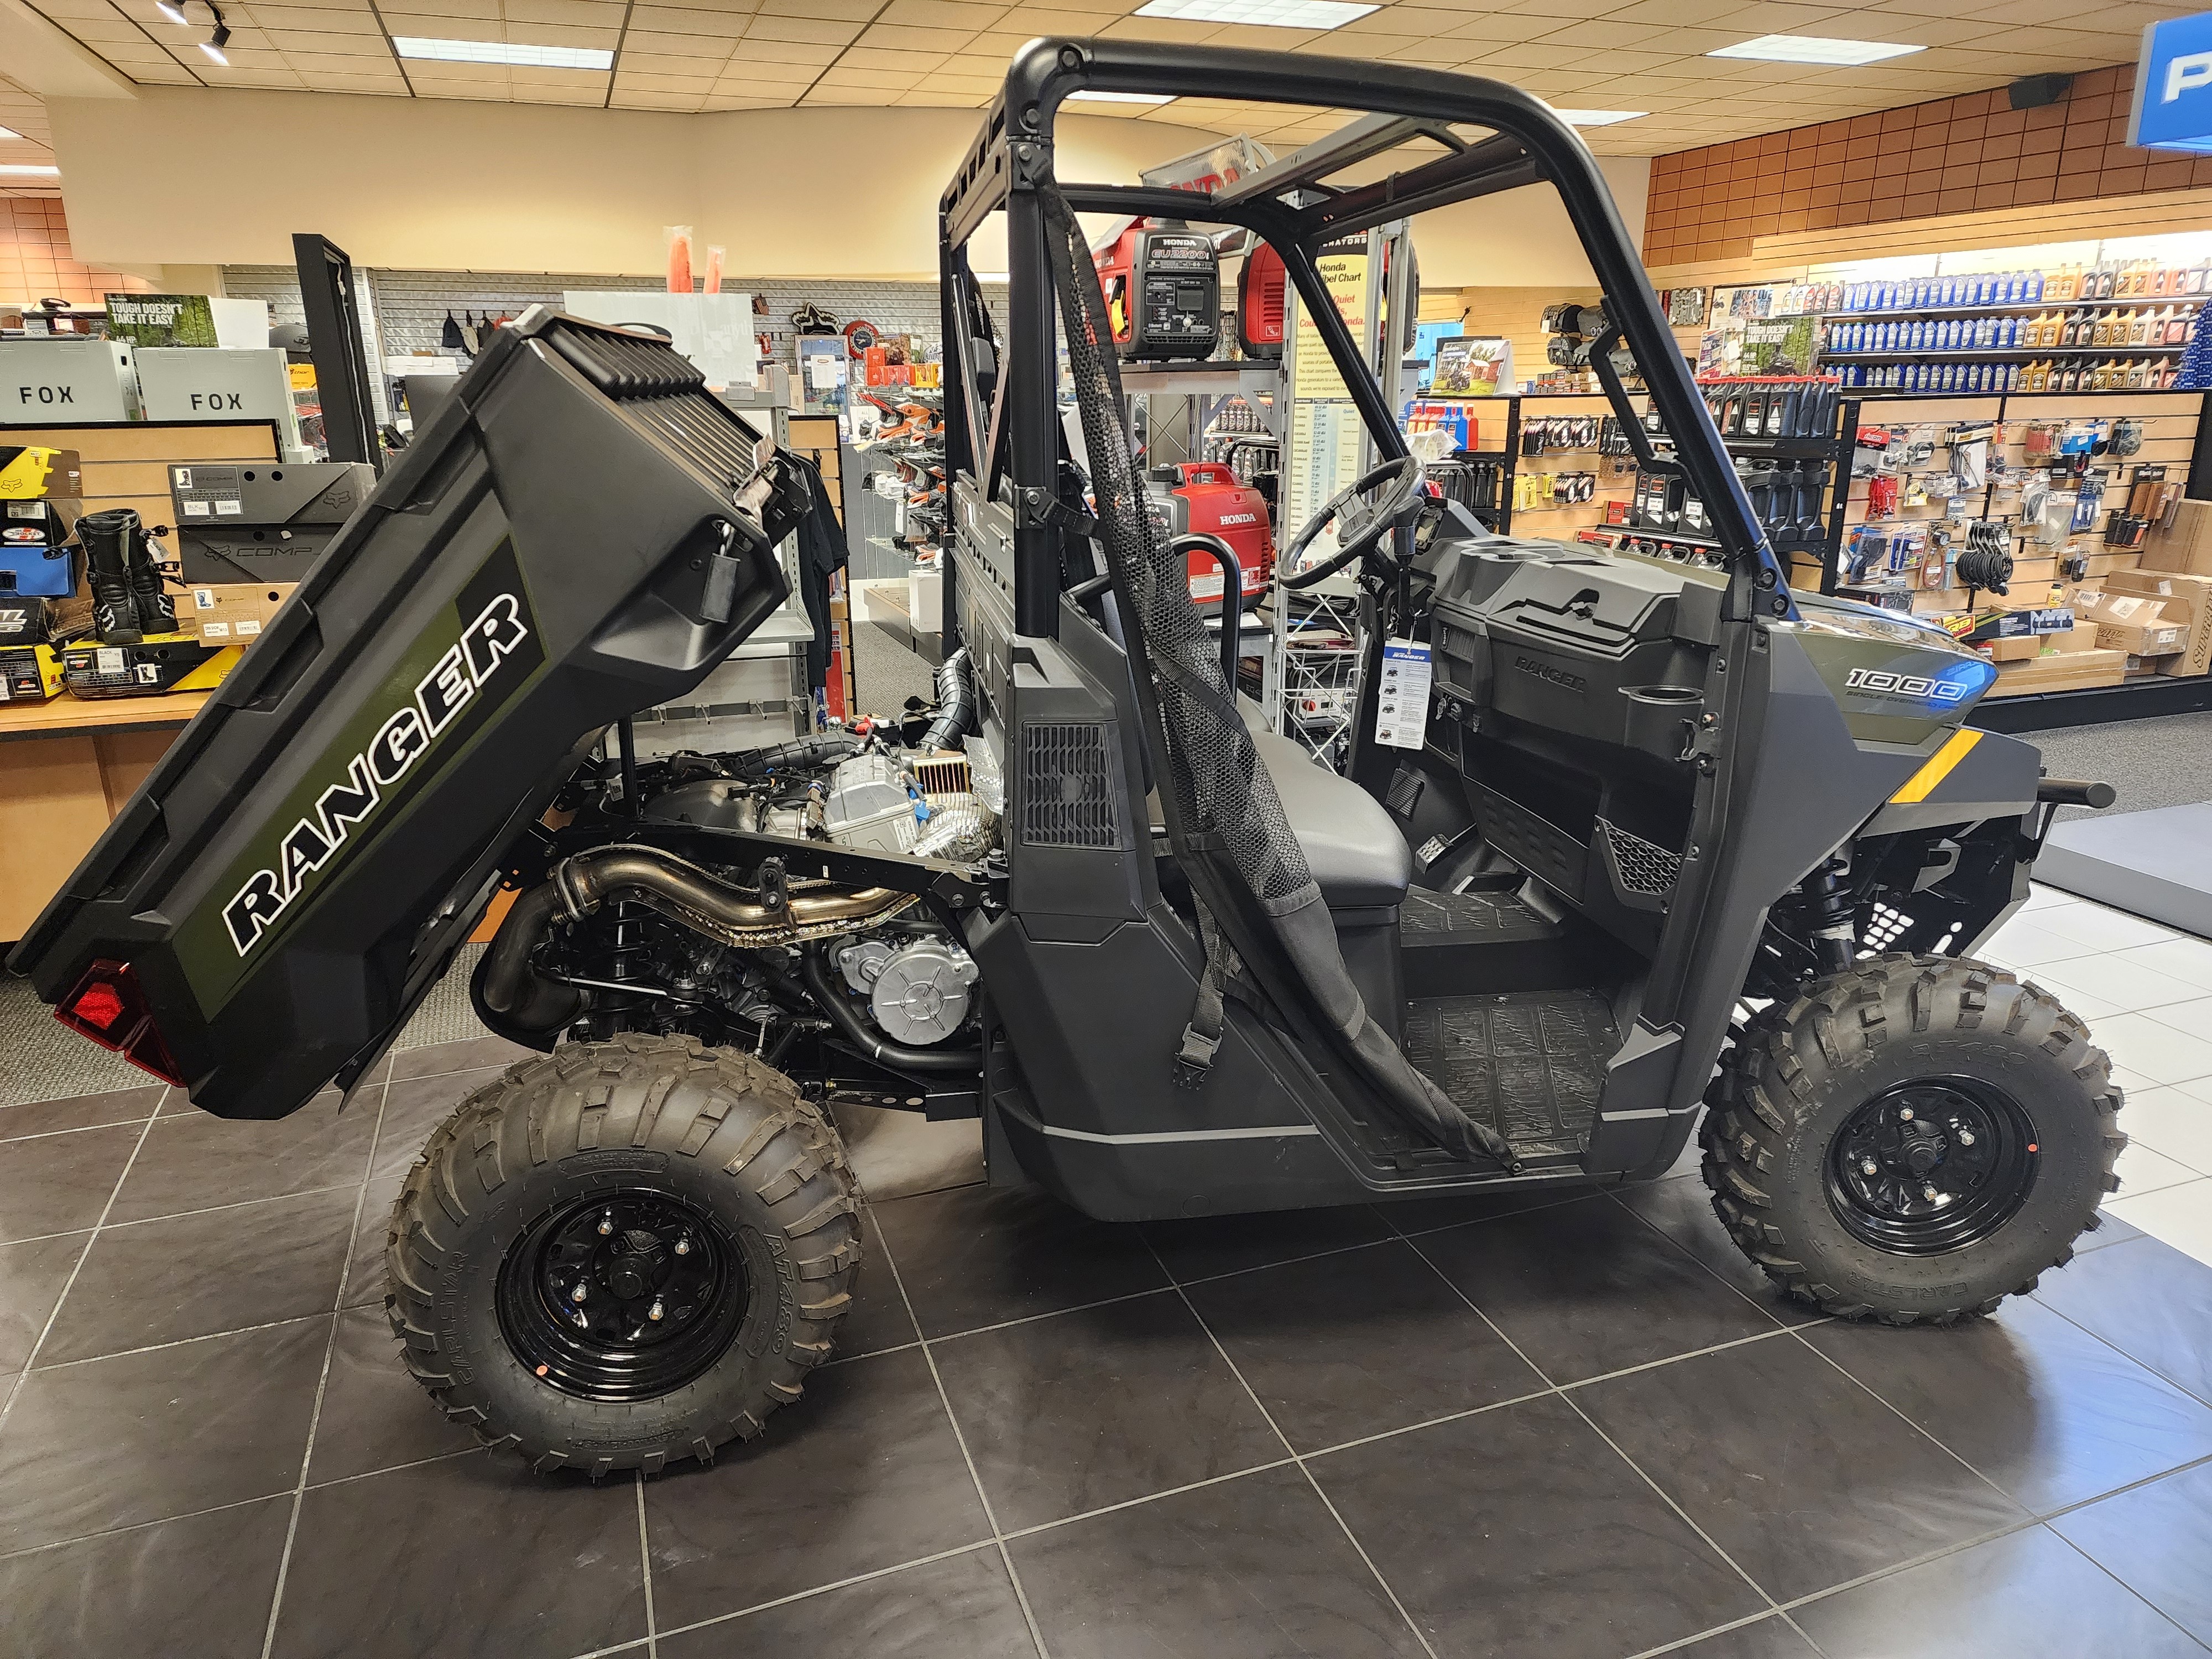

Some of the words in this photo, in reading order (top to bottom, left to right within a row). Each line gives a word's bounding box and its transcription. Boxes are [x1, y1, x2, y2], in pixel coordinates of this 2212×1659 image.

[1151, 249, 1209, 259] EU2200i
[1094, 255, 1114, 269] HONDA
[1319, 263, 1346, 273] Honda
[1338, 273, 1361, 282] Chart
[1333, 294, 1355, 304] Quiet
[109, 302, 142, 313] TOUGH
[142, 304, 183, 315] DOESN'T
[112, 314, 137, 324] TAKE
[137, 314, 147, 324] IT
[149, 314, 174, 325] EASY
[1747, 326, 1766, 335] TOUGH
[1767, 325, 1794, 335] DOESN'T
[1746, 335, 1761, 343] TAKE
[1761, 335, 1768, 343] IT
[1768, 334, 1786, 343] EASY
[19, 386, 74, 404] FOX
[191, 393, 243, 410] FOX
[1219, 513, 1256, 526] HONDA
[236, 546, 312, 557] COMP
[1514, 655, 1587, 693] RANGER
[1845, 668, 1968, 701] 1000
[1846, 691, 1885, 700] SINGLE
[1886, 696, 1937, 707] OVERHEAD
[222, 593, 528, 957] RANGER
[763, 1233, 794, 1355] AT489
[440, 1251, 474, 1385] CARLSTAR
